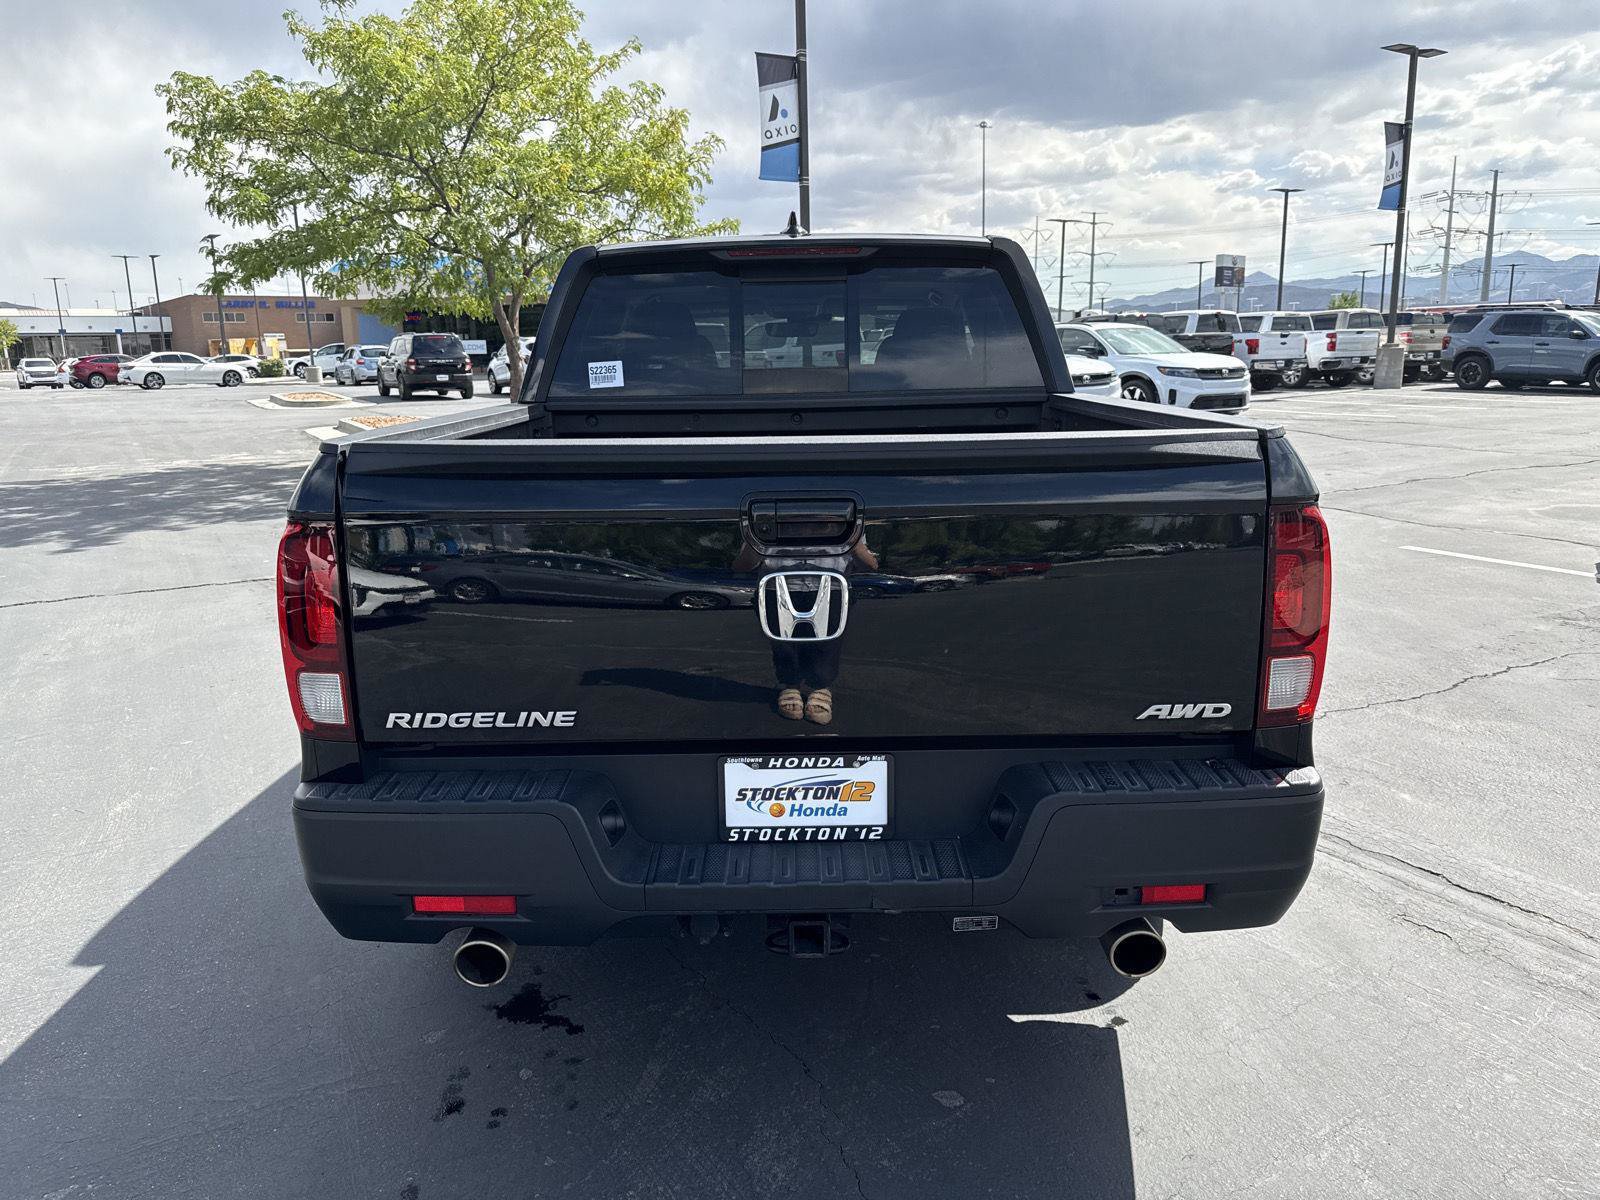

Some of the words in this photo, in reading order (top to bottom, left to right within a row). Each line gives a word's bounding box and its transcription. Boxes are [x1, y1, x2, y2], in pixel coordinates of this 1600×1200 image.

[589, 365, 617, 376] S22365
[1135, 703, 1232, 720] AWD
[385, 710, 577, 729] RIDGELINE
[768, 757, 845, 768] HONDA
[788, 803, 848, 818] Honda
[728, 826, 848, 842] STOCKTON
